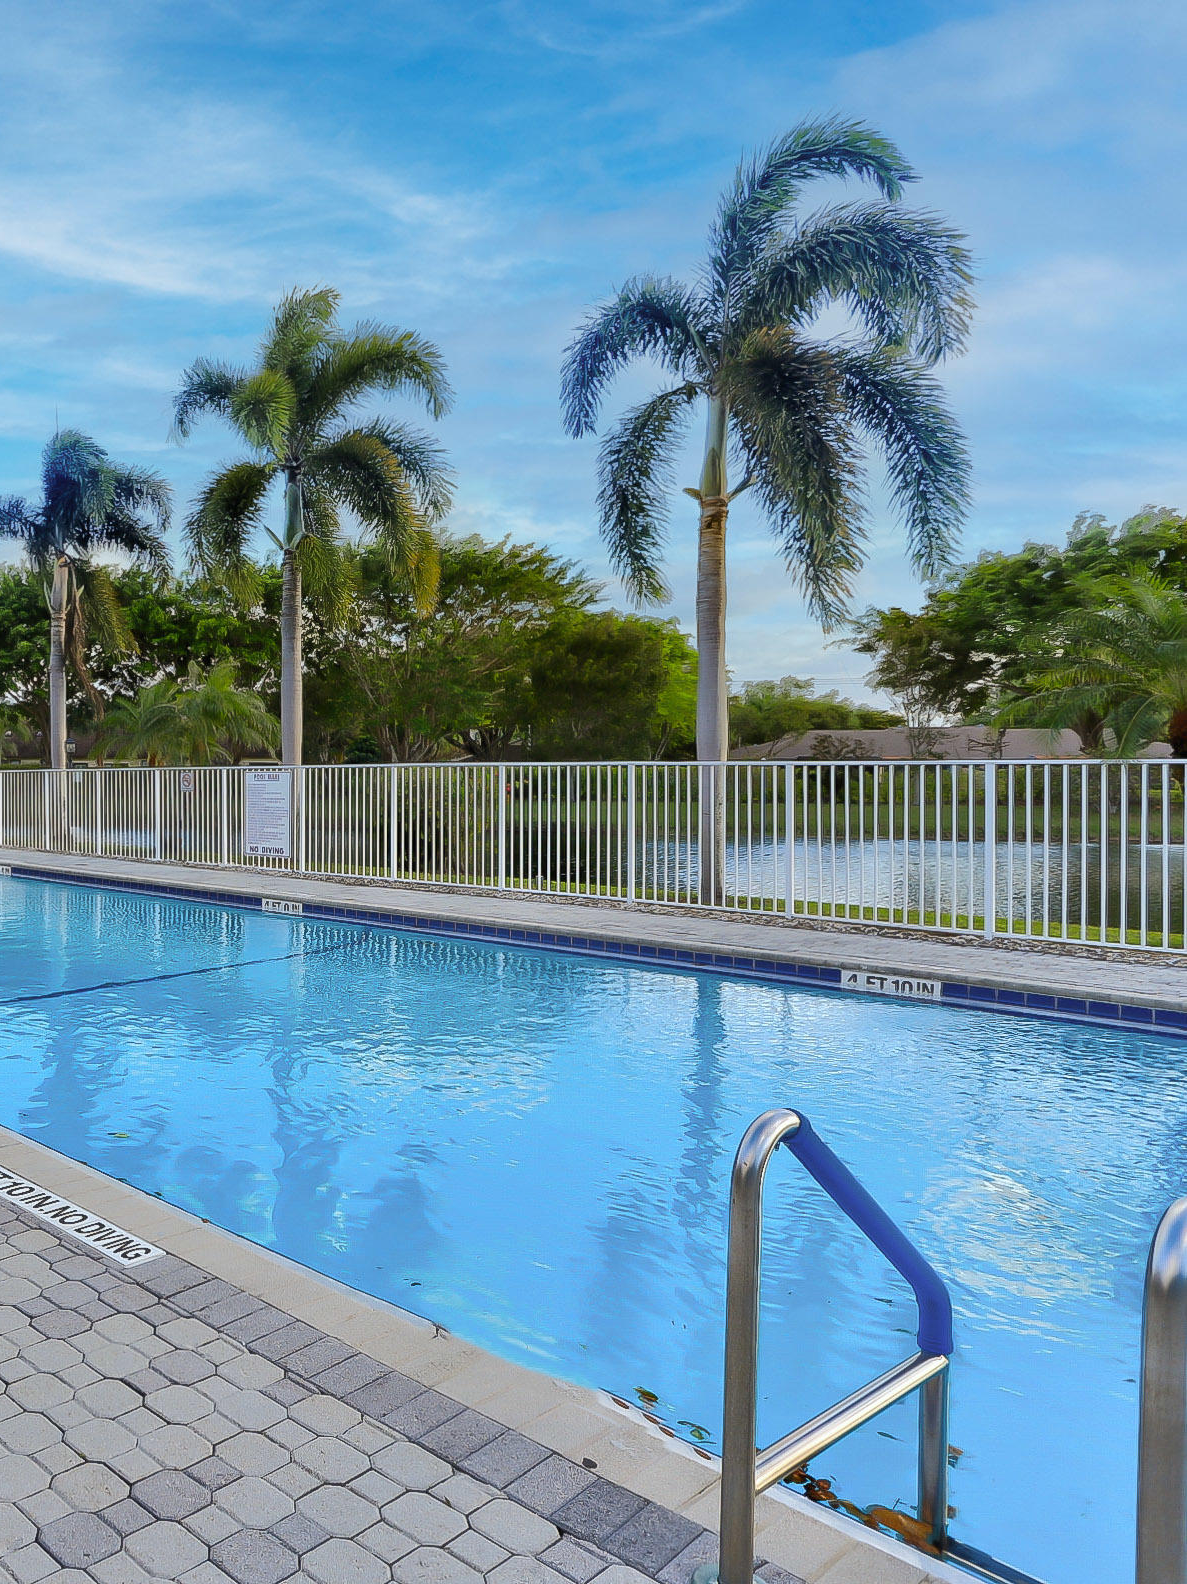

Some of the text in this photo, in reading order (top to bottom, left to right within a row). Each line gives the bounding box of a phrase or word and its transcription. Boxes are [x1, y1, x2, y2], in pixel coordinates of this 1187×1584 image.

[249, 845, 285, 855] NO DIVING
[73, 1221, 152, 1261] DIVING
